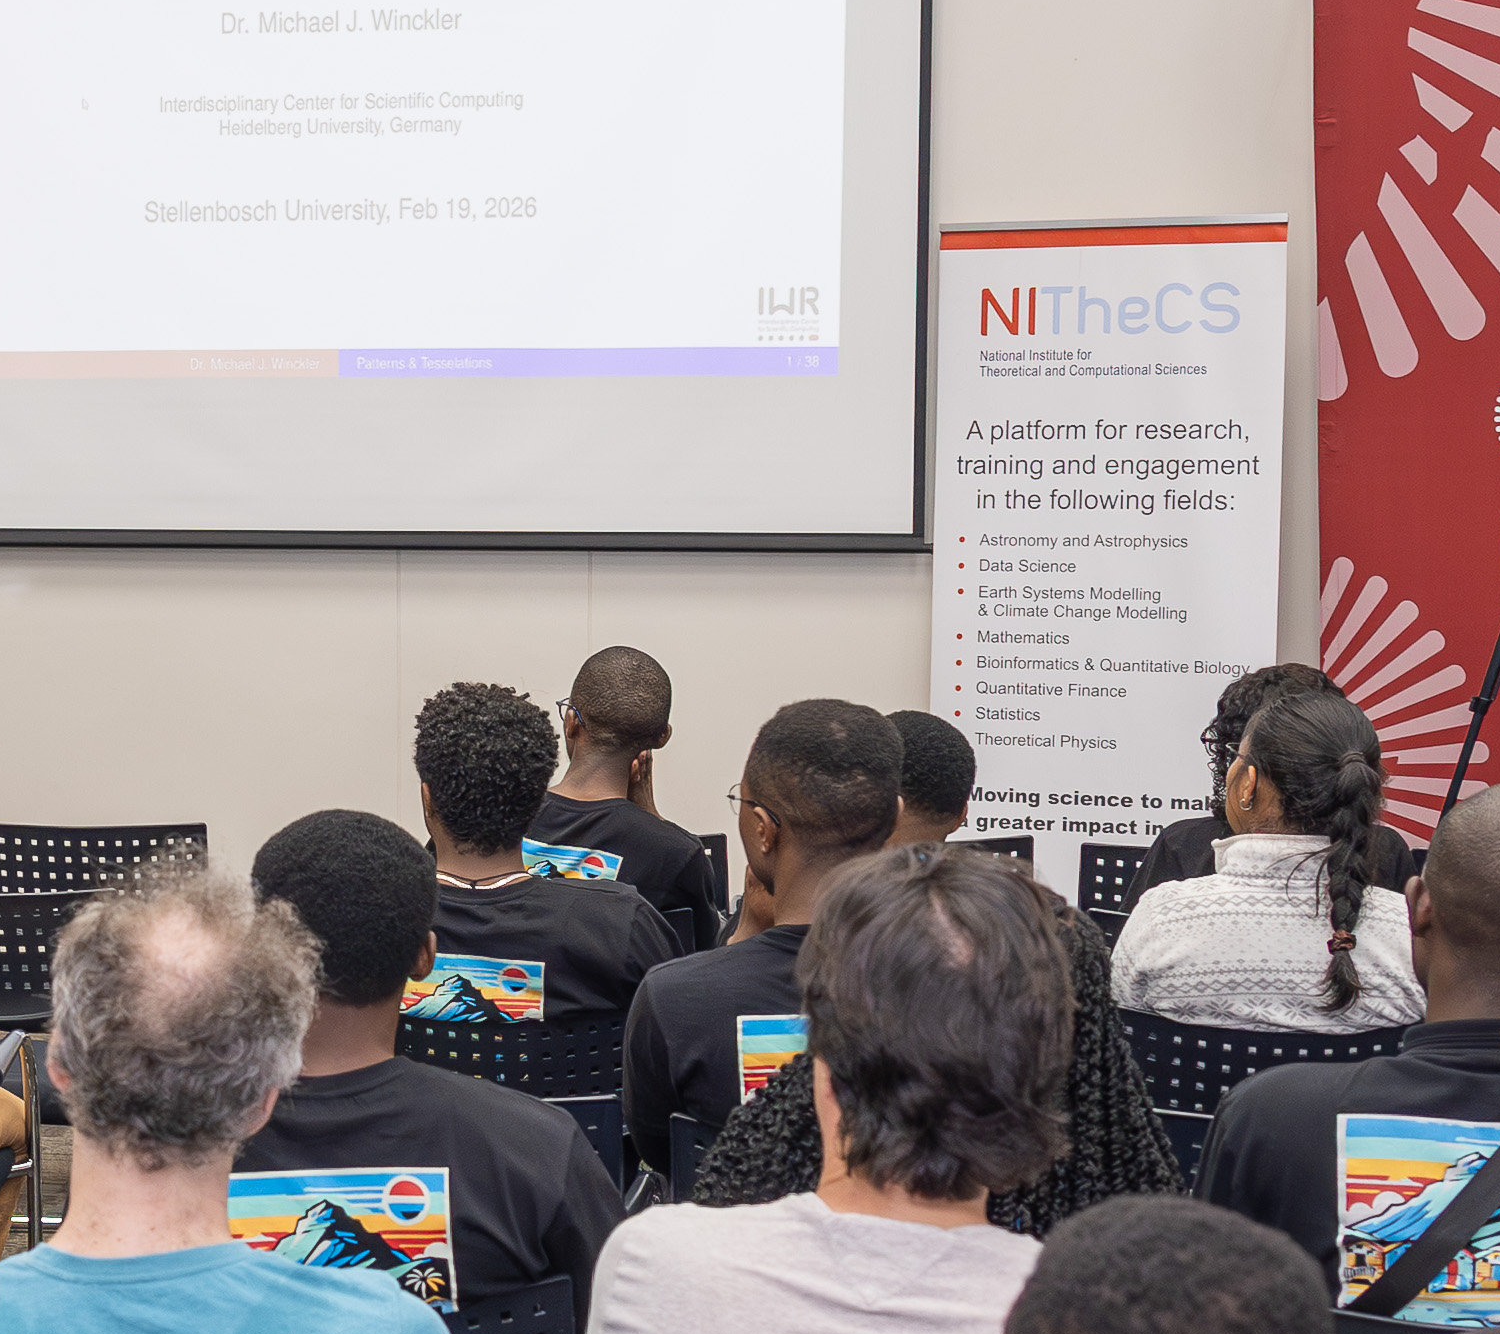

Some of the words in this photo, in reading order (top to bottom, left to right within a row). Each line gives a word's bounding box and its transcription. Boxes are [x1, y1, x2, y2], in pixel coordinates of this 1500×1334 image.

[221, 12, 249, 35] Dr.
[258, 10, 339, 34] Michael
[345, 9, 363, 33] J.
[370, 7, 463, 32] Winckler
[159, 95, 279, 116] Interdisciplinary
[283, 93, 336, 112] Center
[339, 92, 360, 110] for
[364, 91, 435, 110] Scientific
[438, 90, 524, 112] Computing
[219, 118, 302, 139] Heidelberg
[307, 117, 385, 138] University,
[389, 116, 462, 137] Germany
[144, 199, 277, 224] Stellenbosch
[285, 198, 391, 226] University,
[399, 197, 439, 220] Feb
[446, 197, 477, 222] 19,
[484, 196, 537, 219] 2026
[757, 286, 820, 316] IWR
[980, 281, 1241, 336] NITheCS
[979, 349, 1026, 362] National
[1029, 349, 1074, 362] Institute
[1076, 348, 1093, 361] for
[979, 365, 1042, 378] Theoretical
[1045, 364, 1066, 377] and
[1069, 363, 1152, 379] Computational
[1154, 363, 1208, 375] Sciences
[965, 420, 984, 441] A
[990, 419, 1086, 446] platform
[1094, 418, 1128, 440] for
[1135, 418, 1249, 444] research,
[956, 454, 1044, 481] training
[1052, 454, 1096, 475] and
[1105, 455, 1260, 481] engagement
[977, 488, 996, 510] in
[1004, 489, 1042, 510] the
[1049, 488, 1155, 516] following
[1163, 488, 1235, 511] fields:
[979, 533, 1059, 551] Astronomy
[1062, 534, 1090, 547] and
[1093, 534, 1189, 551] Astrophysics
[979, 558, 1013, 573] Data
[1018, 558, 1077, 573] Science
[978, 585, 1017, 599] Earth
[1022, 585, 1085, 603] Systems
[1090, 586, 1161, 604] Modelling
[977, 603, 989, 617] &
[993, 603, 1049, 618] Climate
[1053, 604, 1112, 622] Change
[1116, 605, 1188, 623] Modelling
[977, 629, 1070, 645] Mathematics
[976, 655, 1080, 671] Bioinformatics
[1084, 657, 1095, 671] &
[1099, 658, 1190, 674] Quantitative
[1194, 660, 1250, 678] Biology
[975, 680, 1063, 697] Quantitative
[1068, 683, 1127, 698] Finance
[975, 706, 1041, 722] Statistics
[974, 732, 1056, 749] Theoretical
[1060, 734, 1117, 752] Physics
[970, 786, 1041, 808] Moving
[1047, 790, 1134, 808] science
[1140, 794, 1164, 809] to
[976, 816, 1056, 833] greater
[1062, 816, 1138, 837] impact
